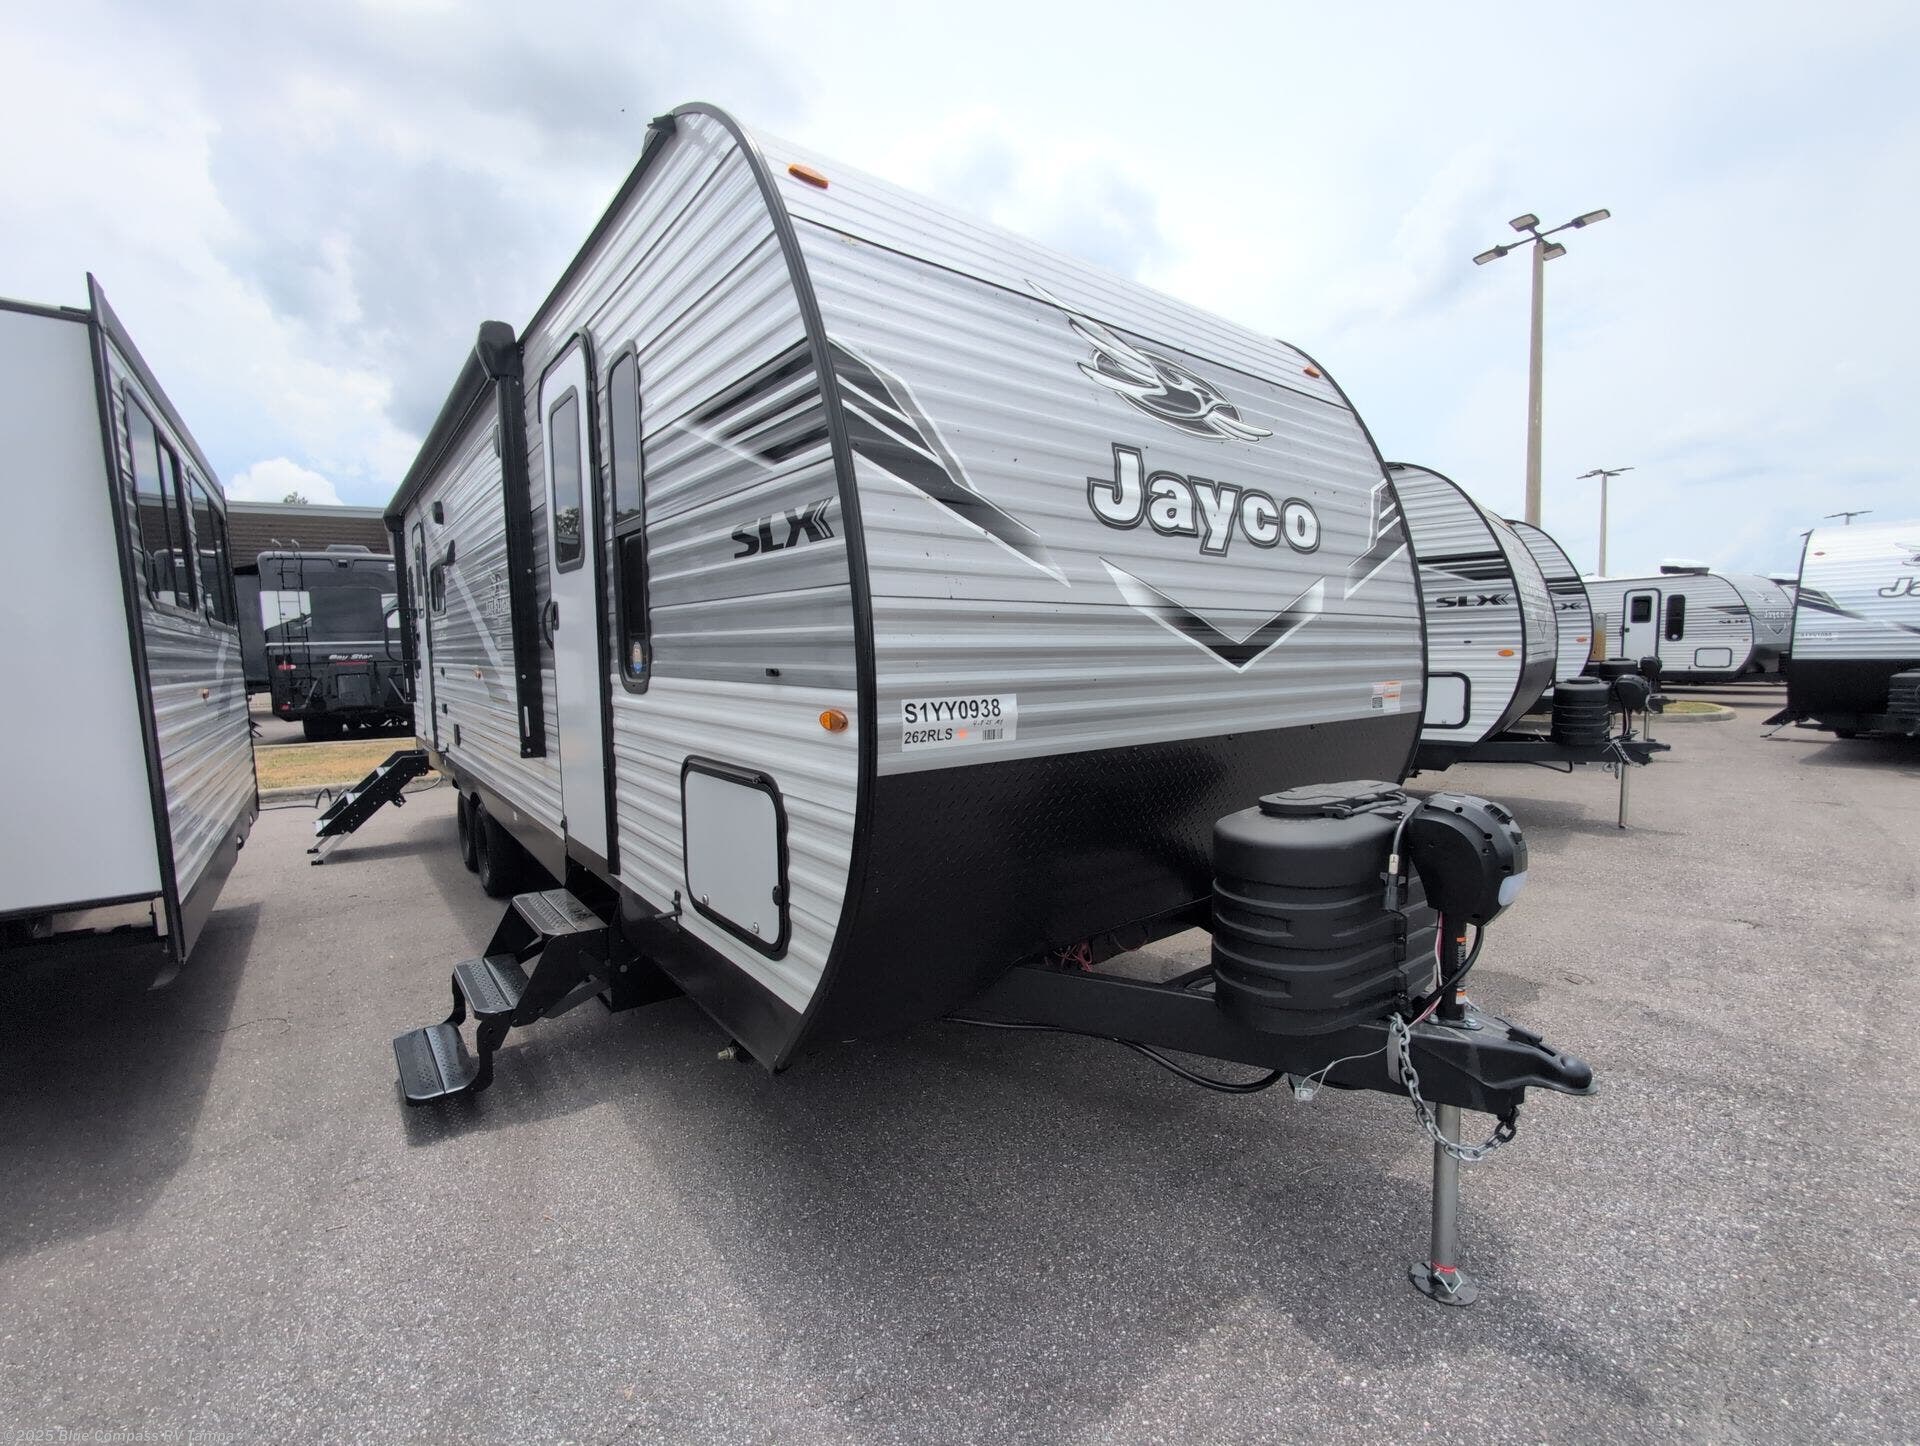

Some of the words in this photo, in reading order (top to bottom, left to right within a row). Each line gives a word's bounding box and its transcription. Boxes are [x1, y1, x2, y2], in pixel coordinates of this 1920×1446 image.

[1087, 442, 1320, 557] Jayco
[731, 496, 834, 559] SLX
[1436, 593, 1510, 608] SLX
[904, 698, 1001, 723] S1YY0938
[904, 728, 953, 744] 262RLS
